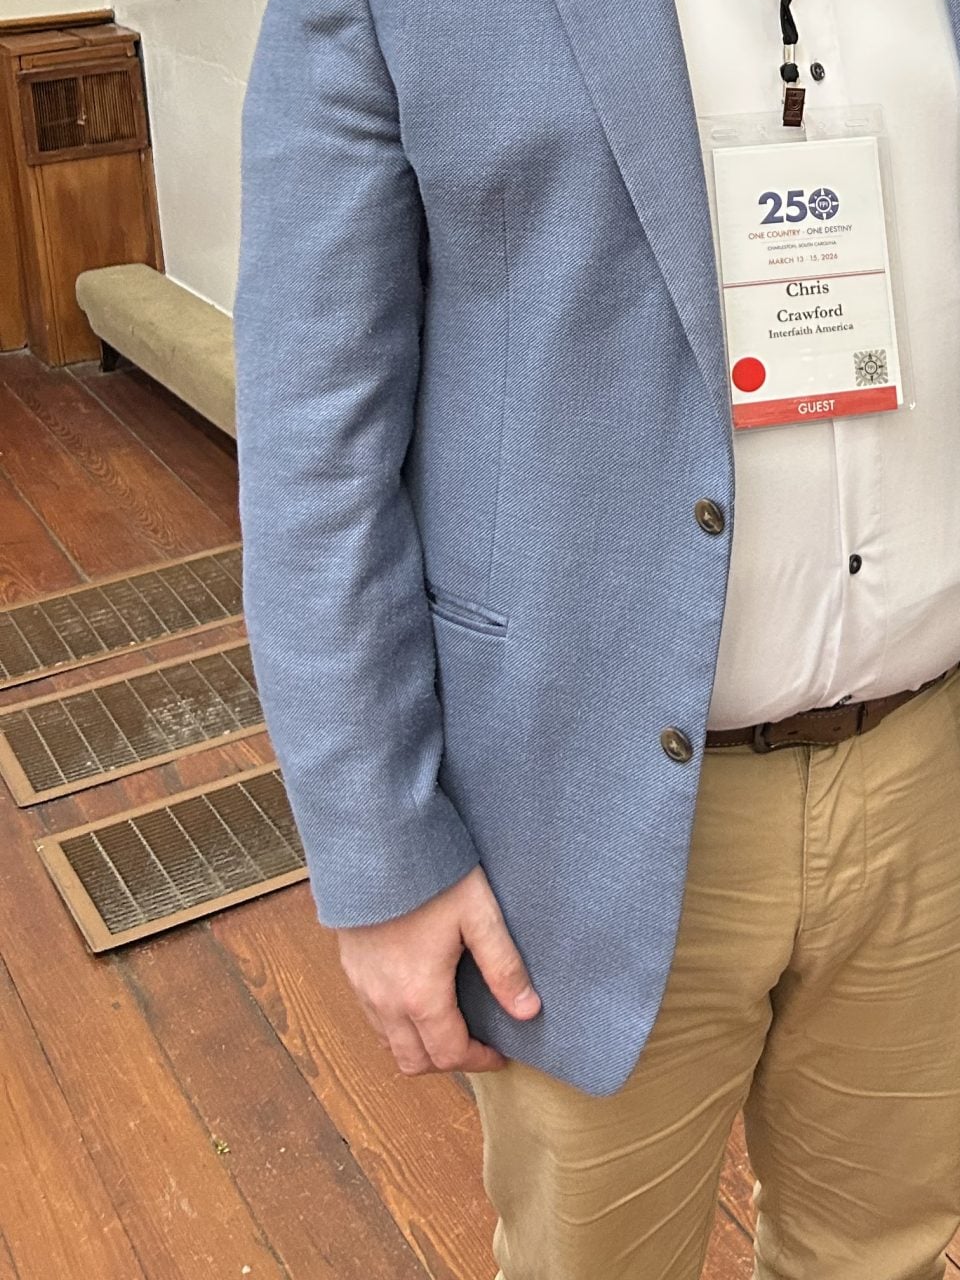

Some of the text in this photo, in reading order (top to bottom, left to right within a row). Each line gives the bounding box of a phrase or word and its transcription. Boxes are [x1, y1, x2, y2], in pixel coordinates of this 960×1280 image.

[758, 187, 840, 225] 250
[748, 224, 853, 240] ONE COUNTRY ONE DESTINY
[768, 256, 795, 266] MARCH
[786, 280, 830, 297] Chris
[776, 304, 844, 323] Crawford
[769, 322, 854, 339] Interfaith America
[798, 400, 835, 414] GUEST
